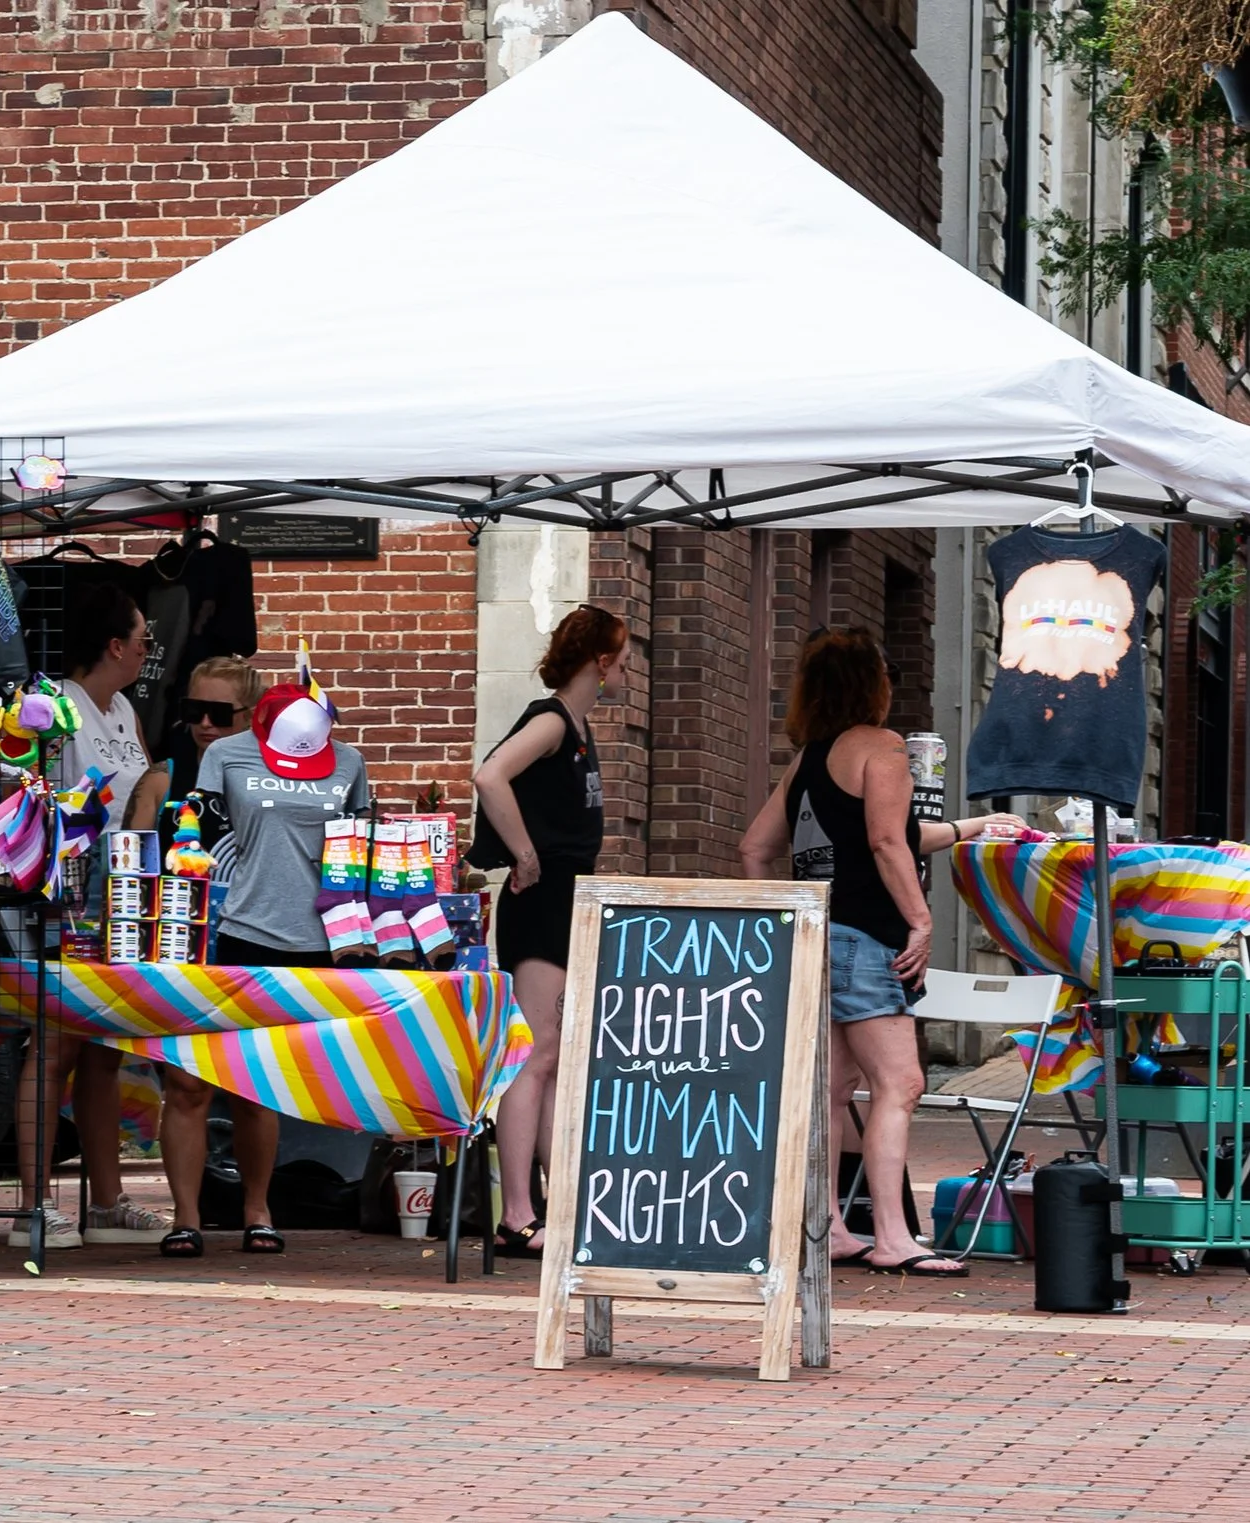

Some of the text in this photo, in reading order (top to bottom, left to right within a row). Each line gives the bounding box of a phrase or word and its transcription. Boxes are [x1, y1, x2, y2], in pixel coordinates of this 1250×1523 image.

[1020, 599, 1117, 624] U-HAUL
[246, 777, 327, 796] EQUAL
[606, 916, 775, 978] TRANS
[596, 977, 766, 1058] RIGHTS
[588, 1079, 767, 1159] HUMAN
[584, 1160, 749, 1247] RIGHTS
